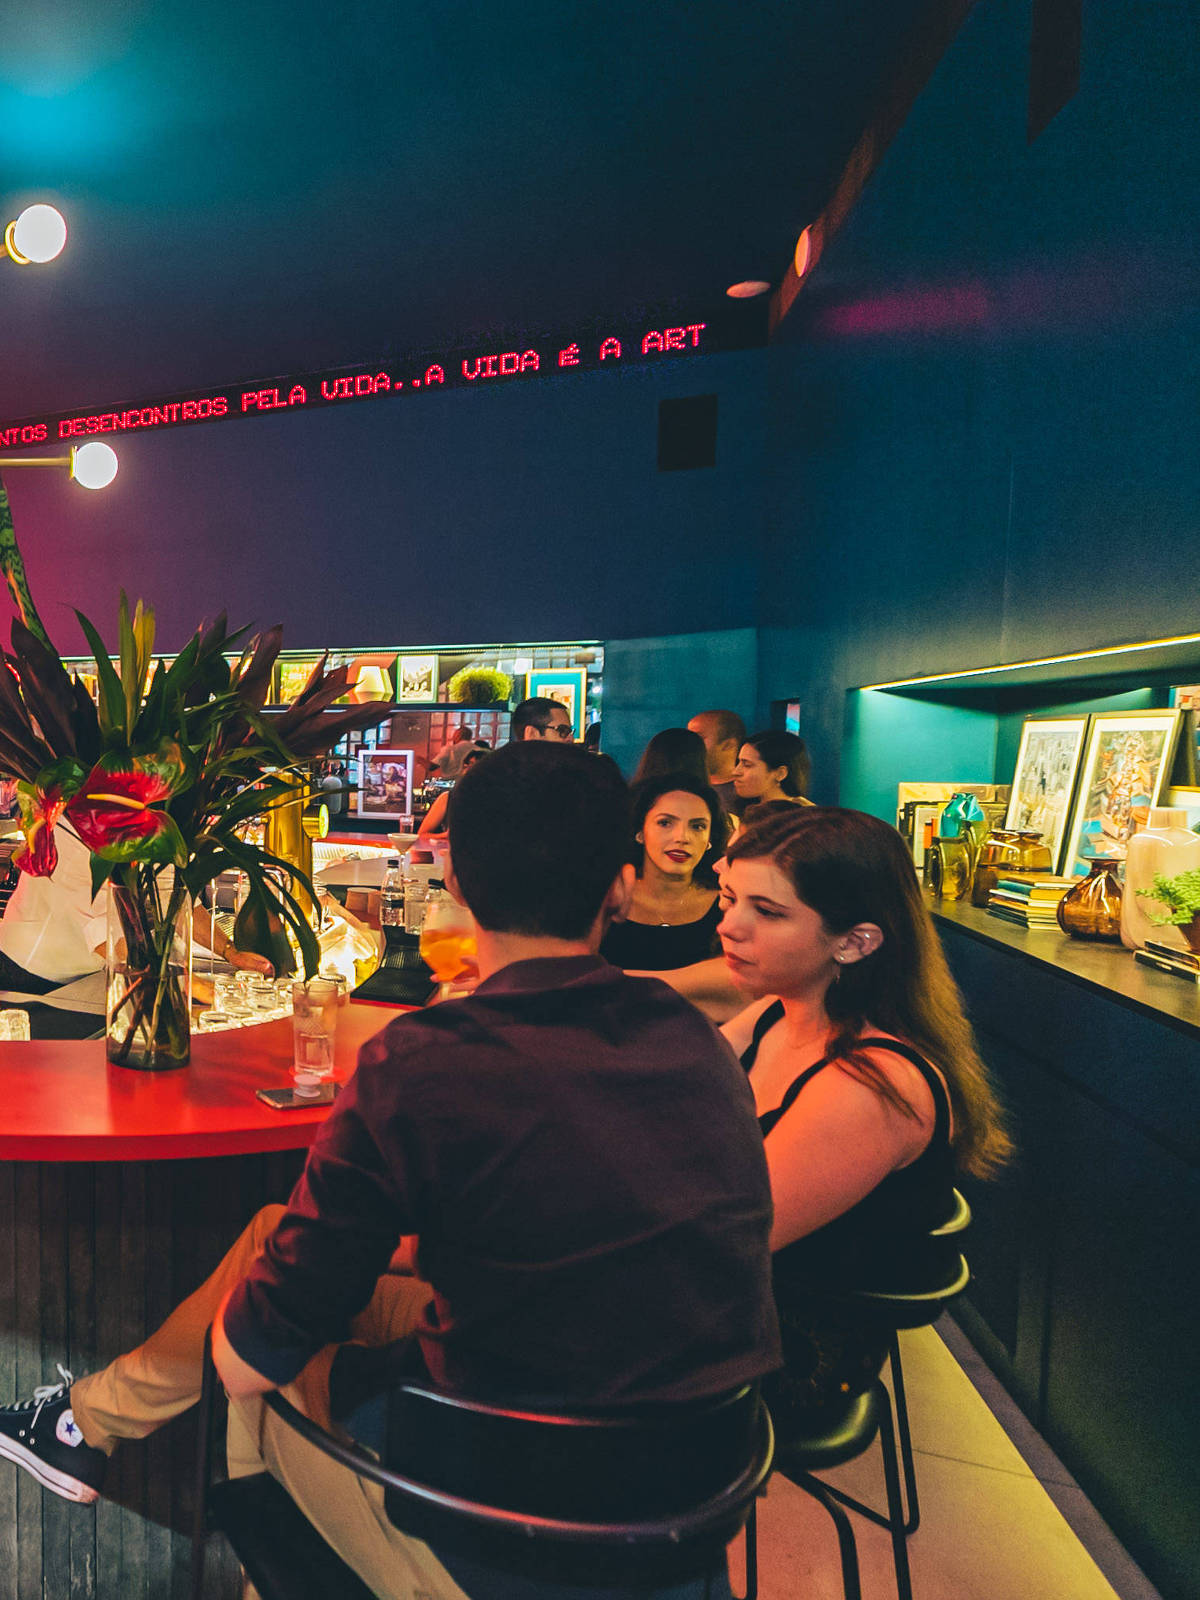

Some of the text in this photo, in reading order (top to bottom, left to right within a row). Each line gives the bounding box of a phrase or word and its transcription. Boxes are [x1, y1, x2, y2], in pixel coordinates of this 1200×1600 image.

[58, 396, 228, 438] DESENCONTROS
[241, 384, 307, 412] PELA
[462, 349, 540, 380] VIDA
[559, 343, 580, 367] É
[599, 337, 621, 360] A
